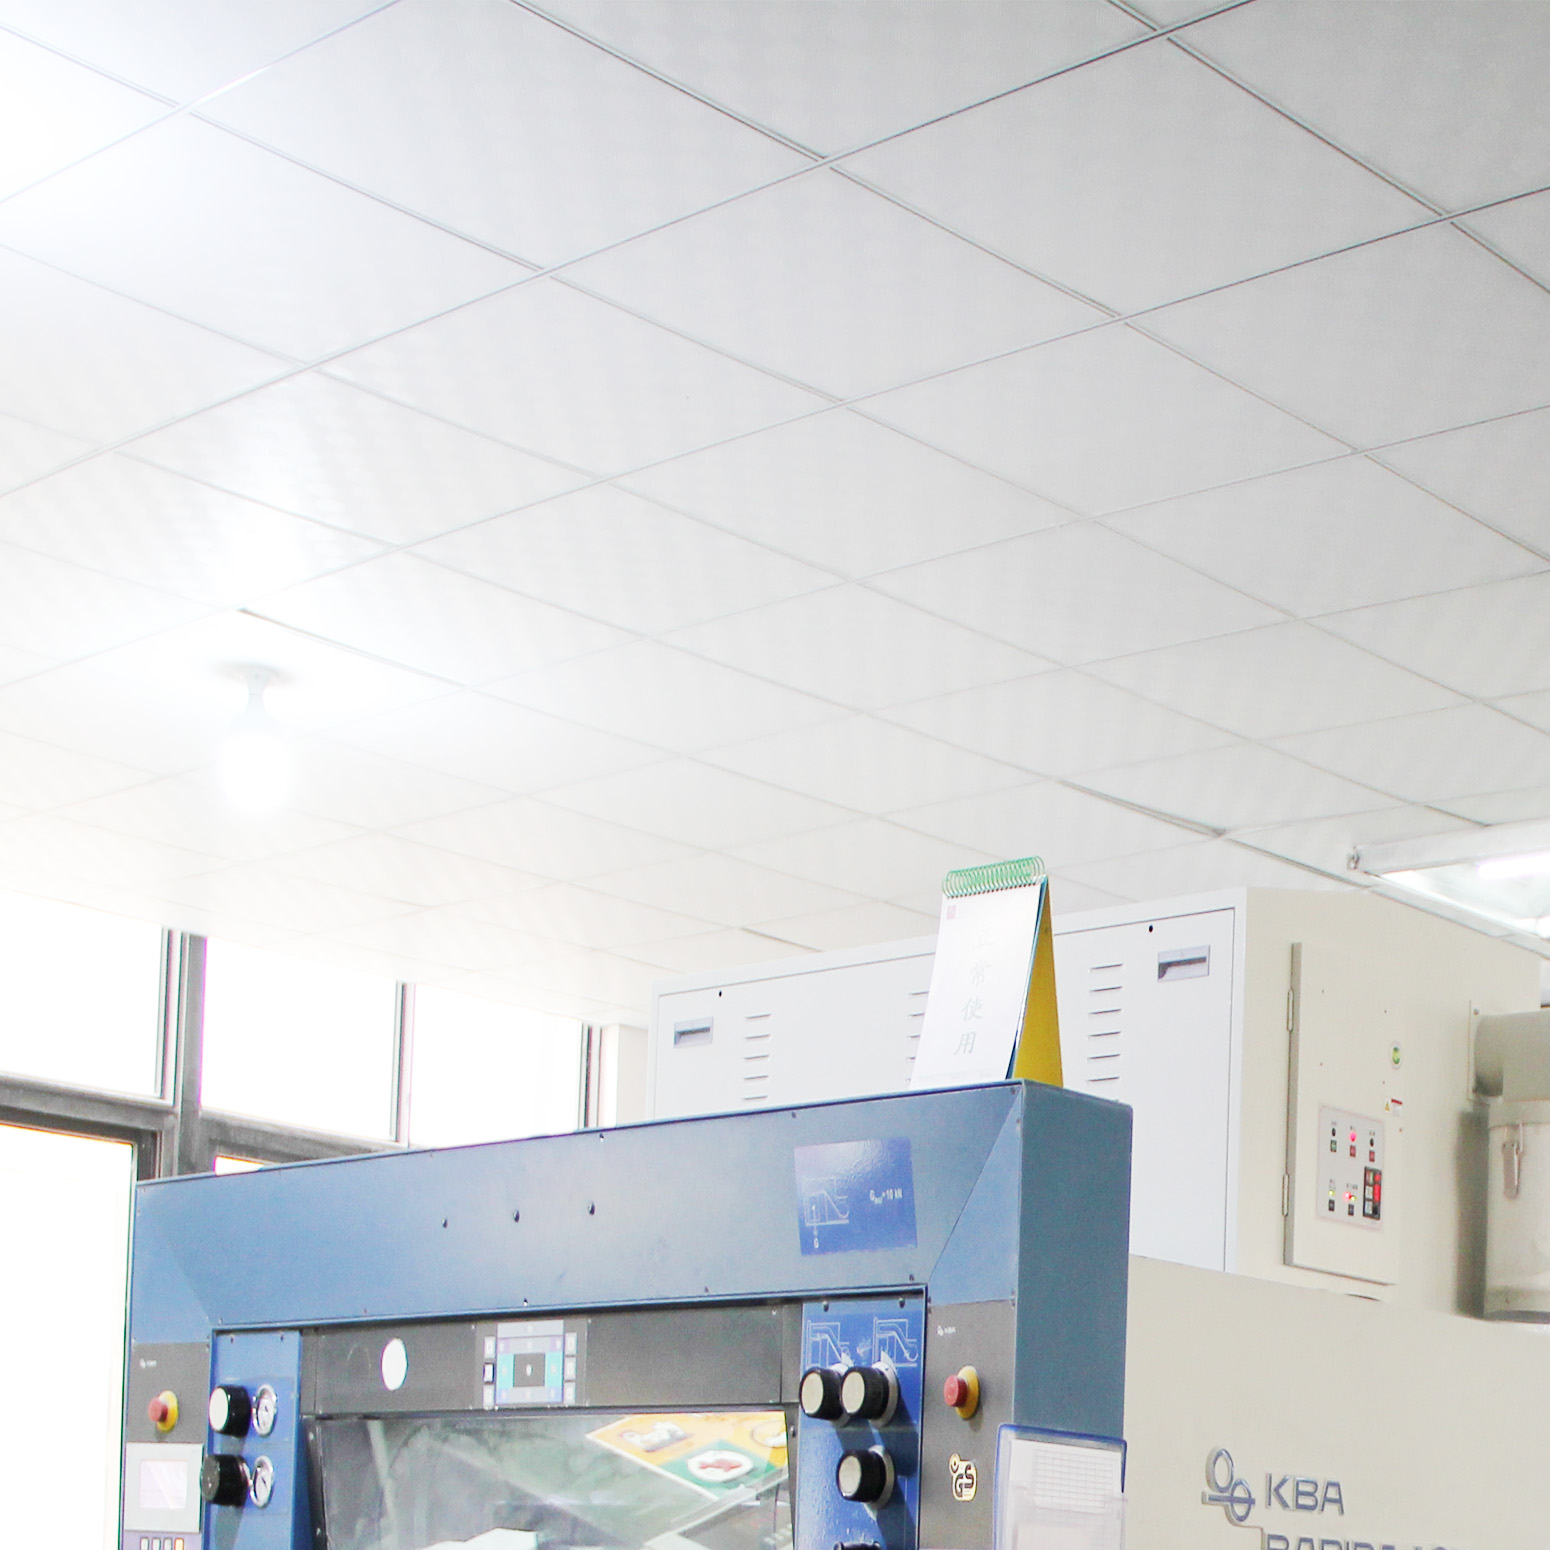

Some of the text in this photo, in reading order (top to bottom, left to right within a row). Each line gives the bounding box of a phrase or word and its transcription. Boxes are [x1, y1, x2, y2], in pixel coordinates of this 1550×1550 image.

[953, 927, 995, 1056] 正常使用
[1265, 1472, 1345, 1516] KBA
